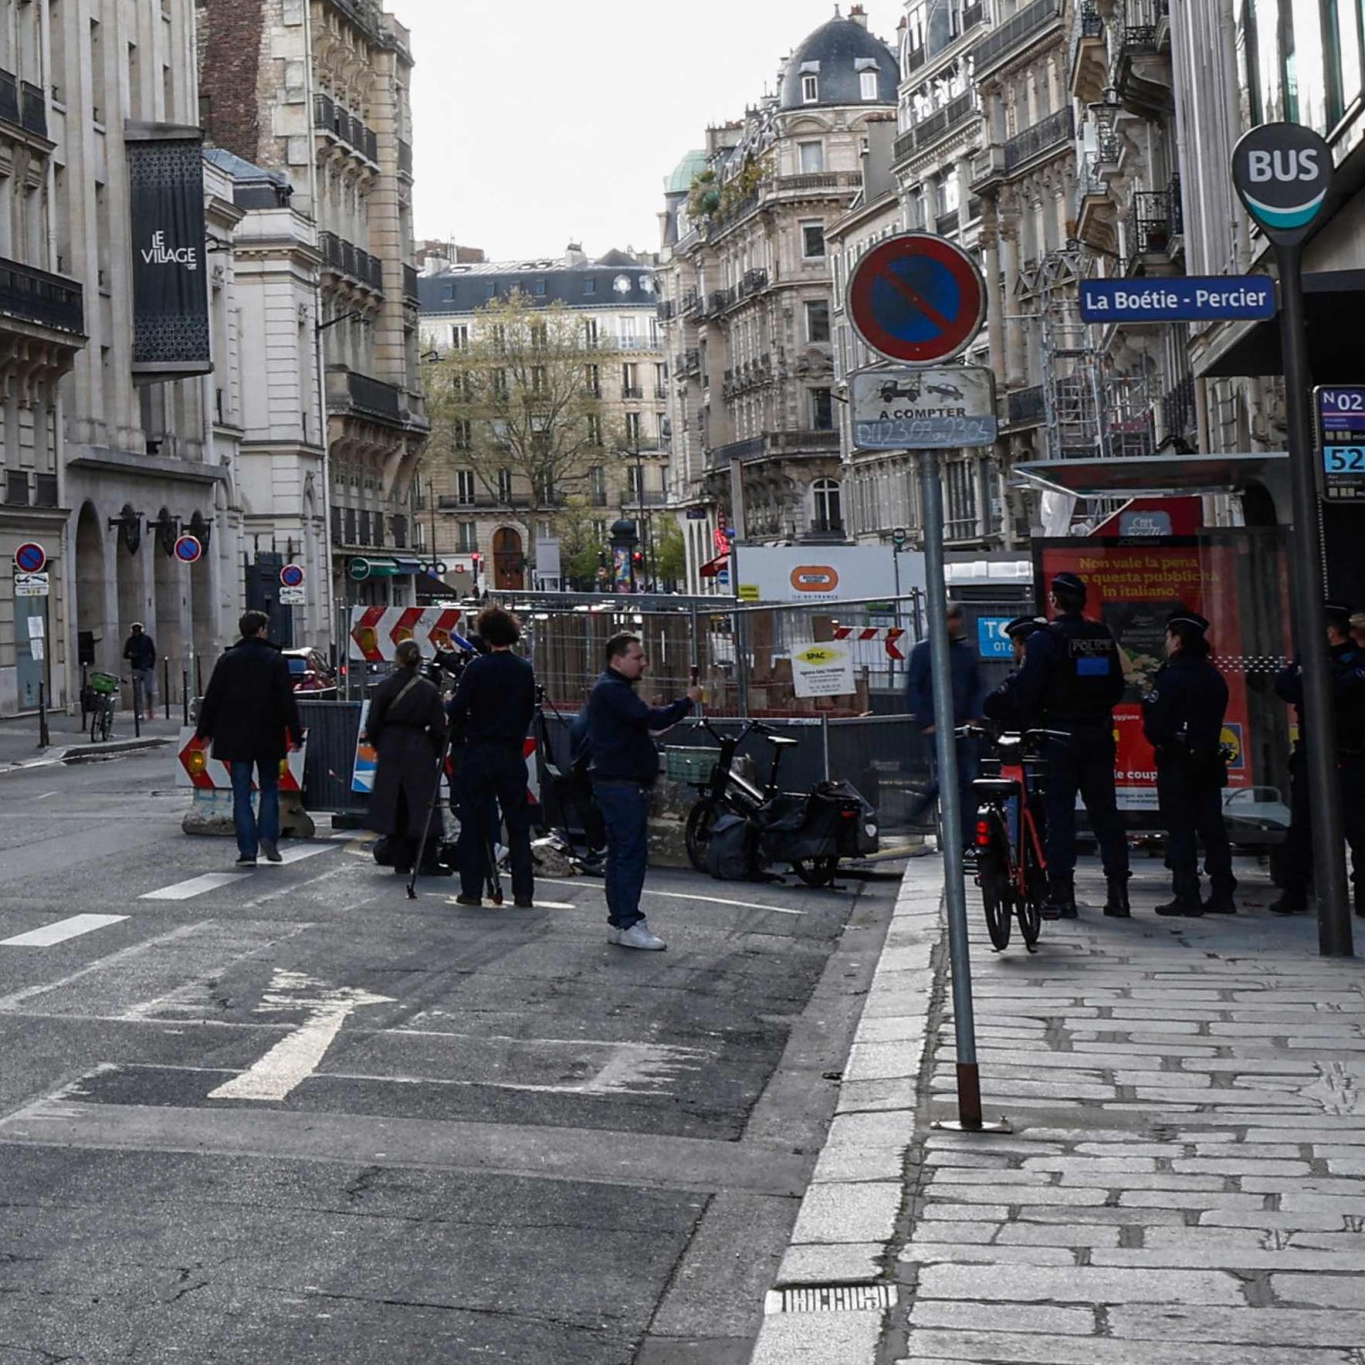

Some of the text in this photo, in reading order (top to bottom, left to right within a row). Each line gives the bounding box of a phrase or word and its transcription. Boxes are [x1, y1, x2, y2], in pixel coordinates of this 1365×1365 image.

[1248, 149, 1319, 182] BUS
[152, 231, 164, 248] LE
[141, 246, 197, 264] VILLAGE
[1086, 292, 1108, 310] La
[1115, 290, 1178, 309] Boétie
[1196, 288, 1266, 307] Percier
[894, 408, 966, 419] COMPTER
[1331, 448, 1365, 471] 52
[1080, 556, 1198, 570] Non vale la pena
[1093, 573, 1141, 585] questa
[993, 641, 1006, 652] 01
[1072, 639, 1112, 652] POLICE
[806, 652, 826, 660] SPAC
